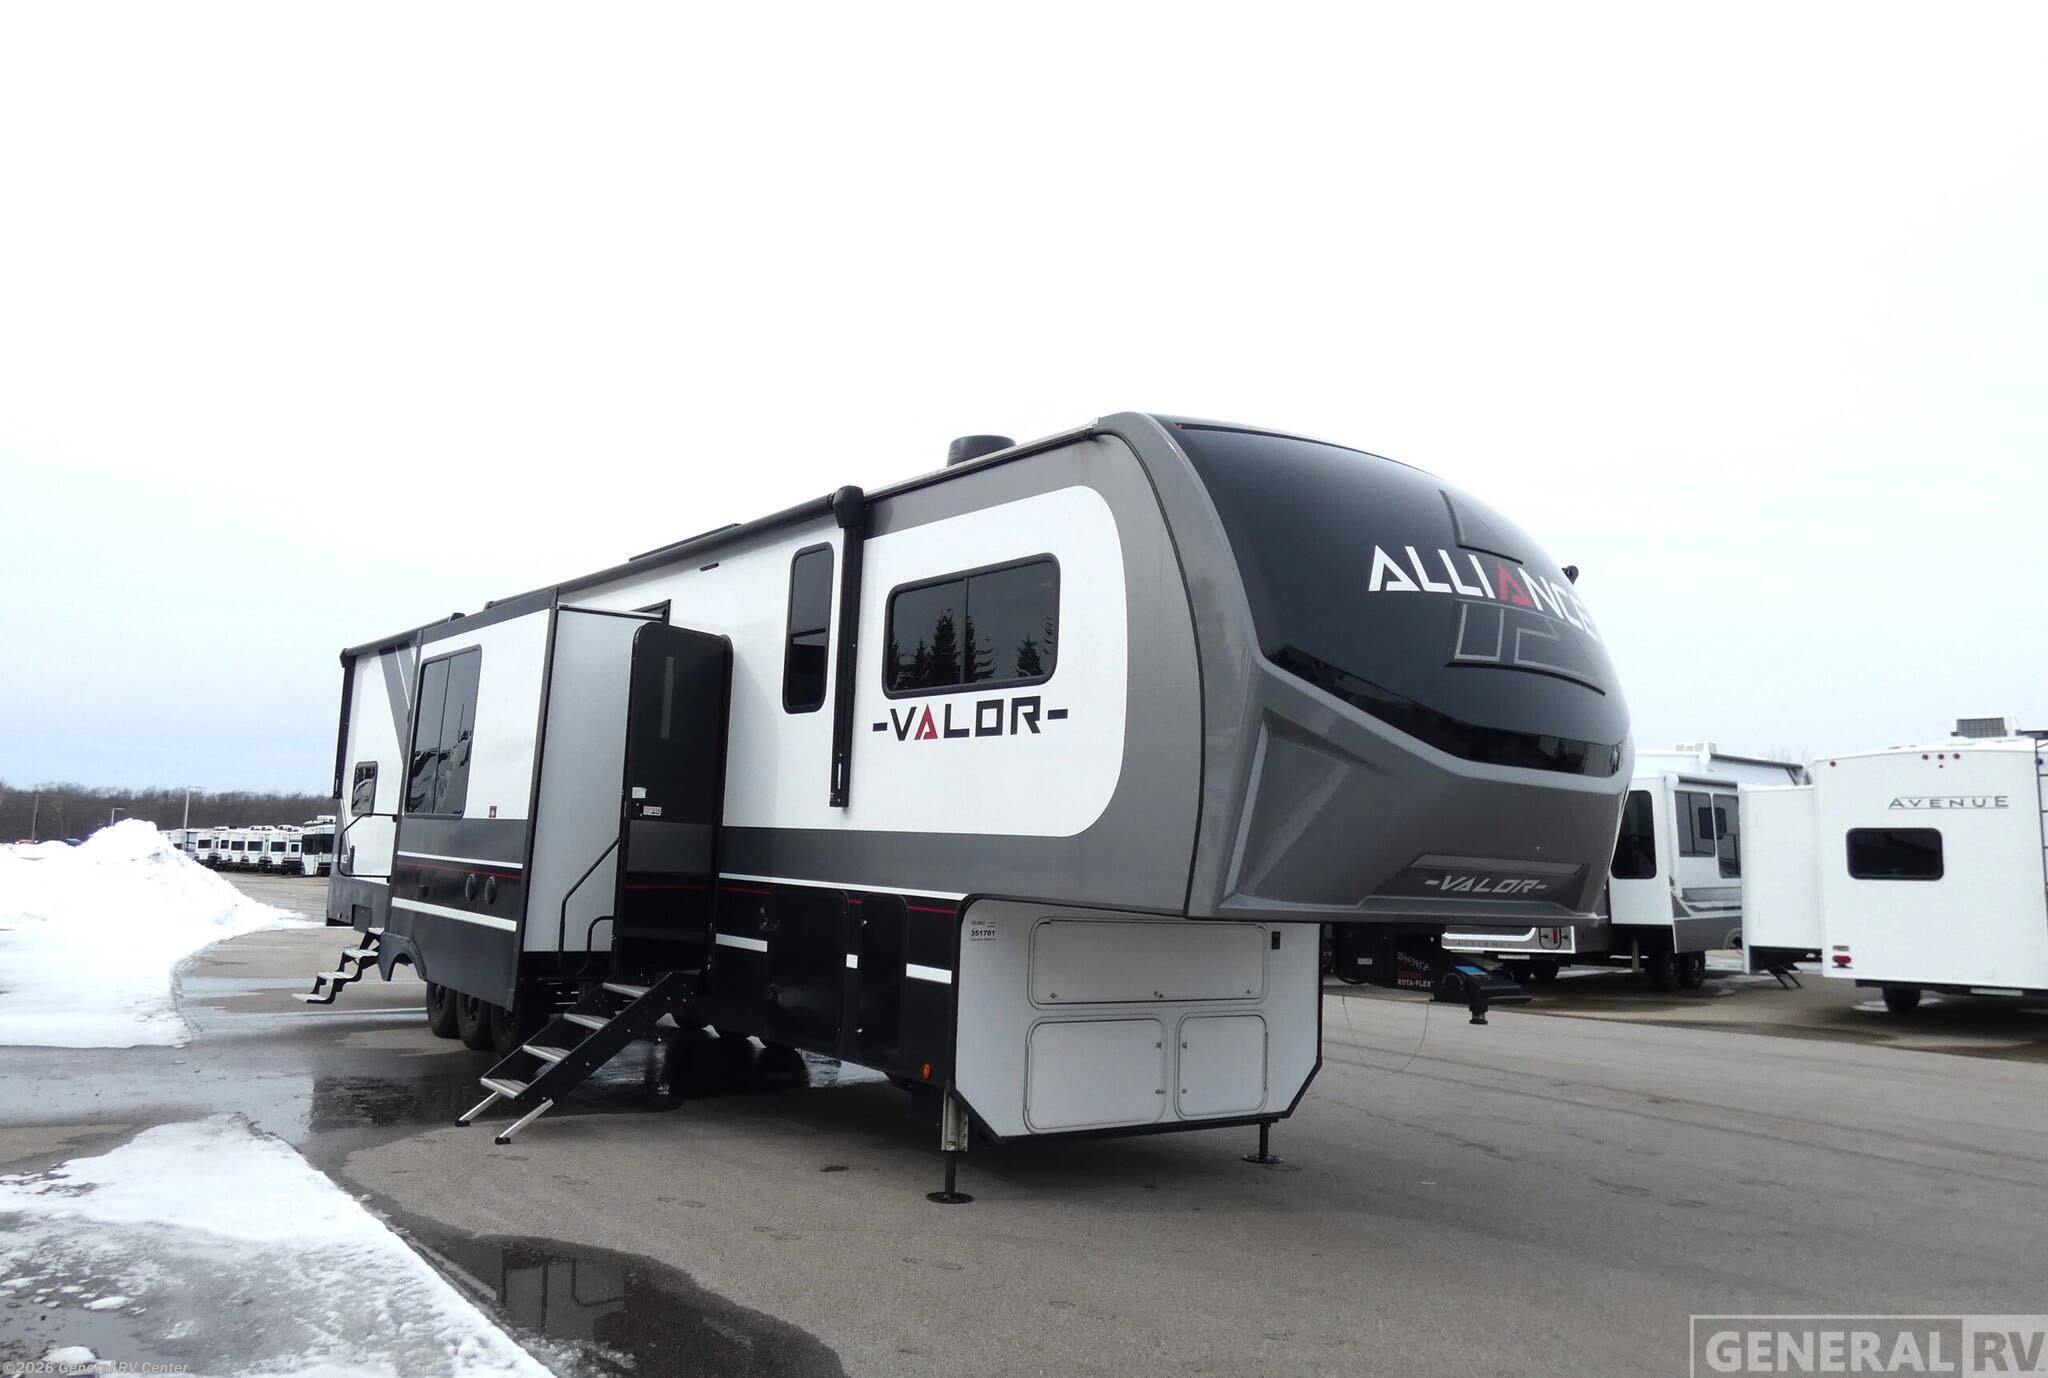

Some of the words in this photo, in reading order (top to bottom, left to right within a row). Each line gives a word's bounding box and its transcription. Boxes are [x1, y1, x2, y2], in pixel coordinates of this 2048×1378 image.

[1368, 545, 1600, 643] ALLIANCE
[1887, 795, 2008, 808] AVENUE
[970, 929, 996, 937] 351701
